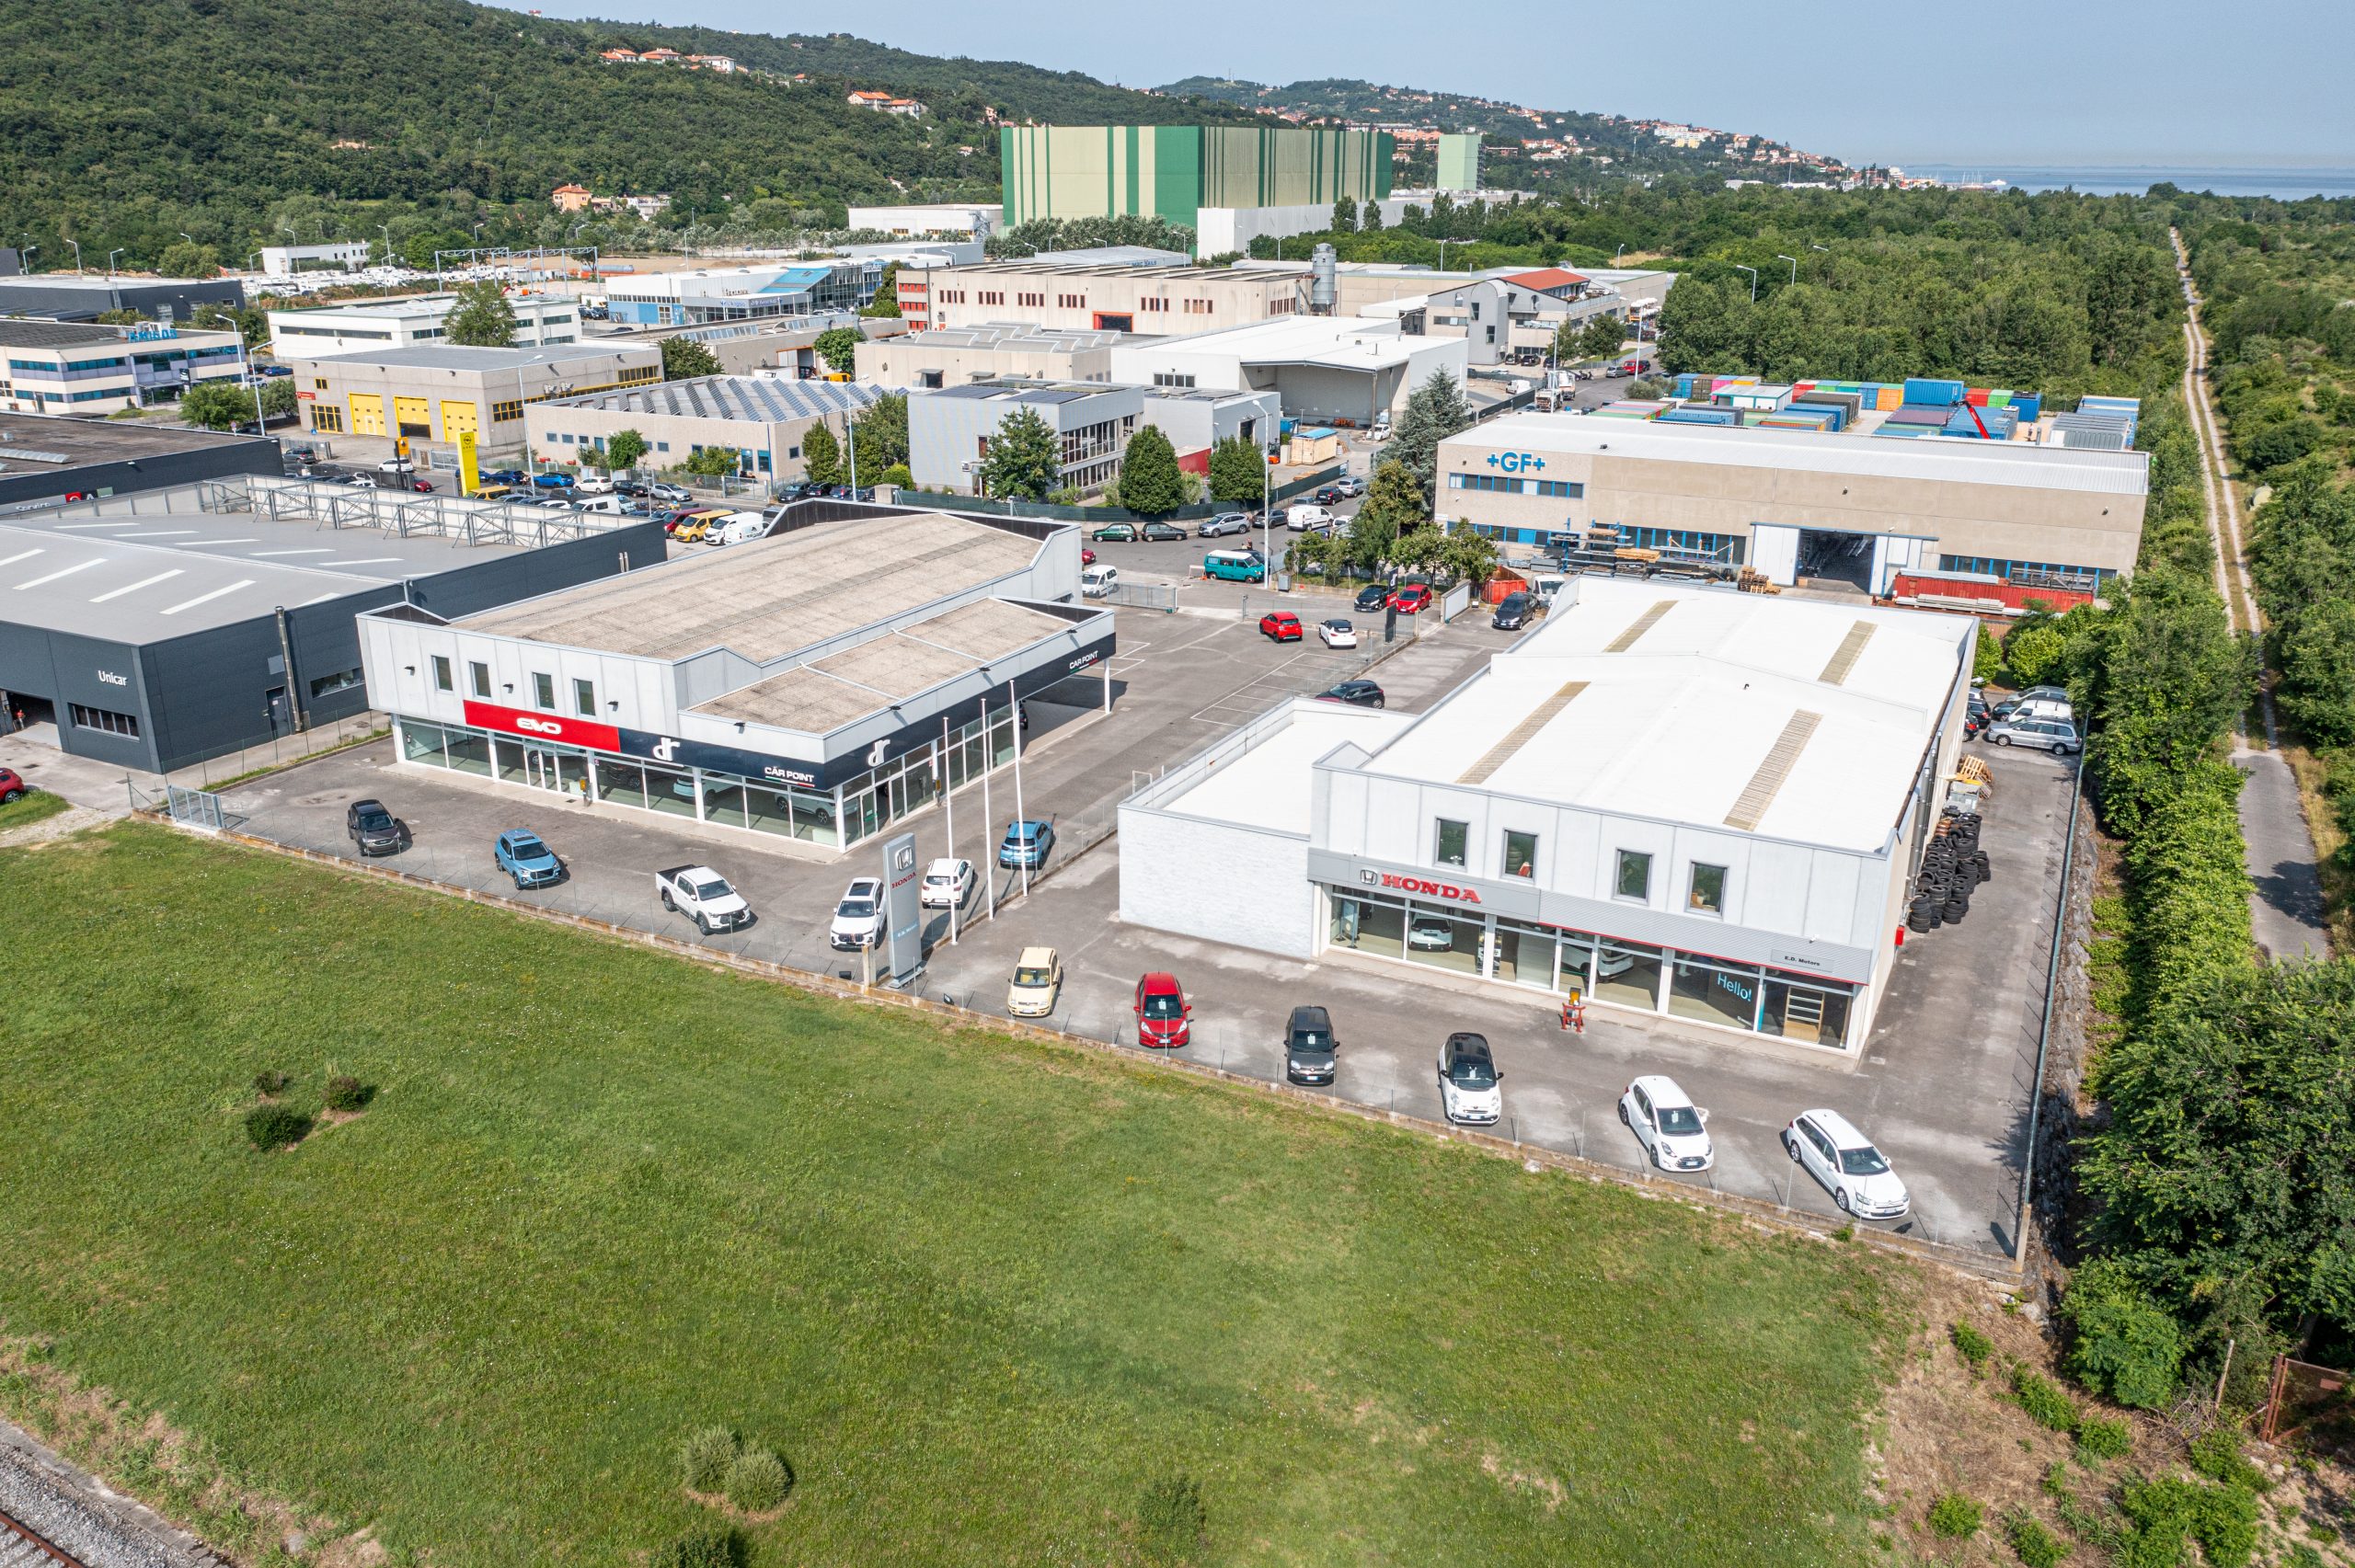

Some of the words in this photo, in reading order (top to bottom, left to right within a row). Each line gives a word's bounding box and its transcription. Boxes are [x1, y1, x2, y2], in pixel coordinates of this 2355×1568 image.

[1069, 658, 1082, 670] CAR
[1082, 650, 1098, 664] POINT
[98, 670, 127, 686] Unicar
[764, 766, 786, 777] CAR
[786, 770, 815, 783] POINT
[891, 871, 917, 888] HONDA
[1382, 873, 1482, 904] HONDA
[1798, 957, 1821, 967] Motors
[1717, 972, 1752, 1002] Hello!
